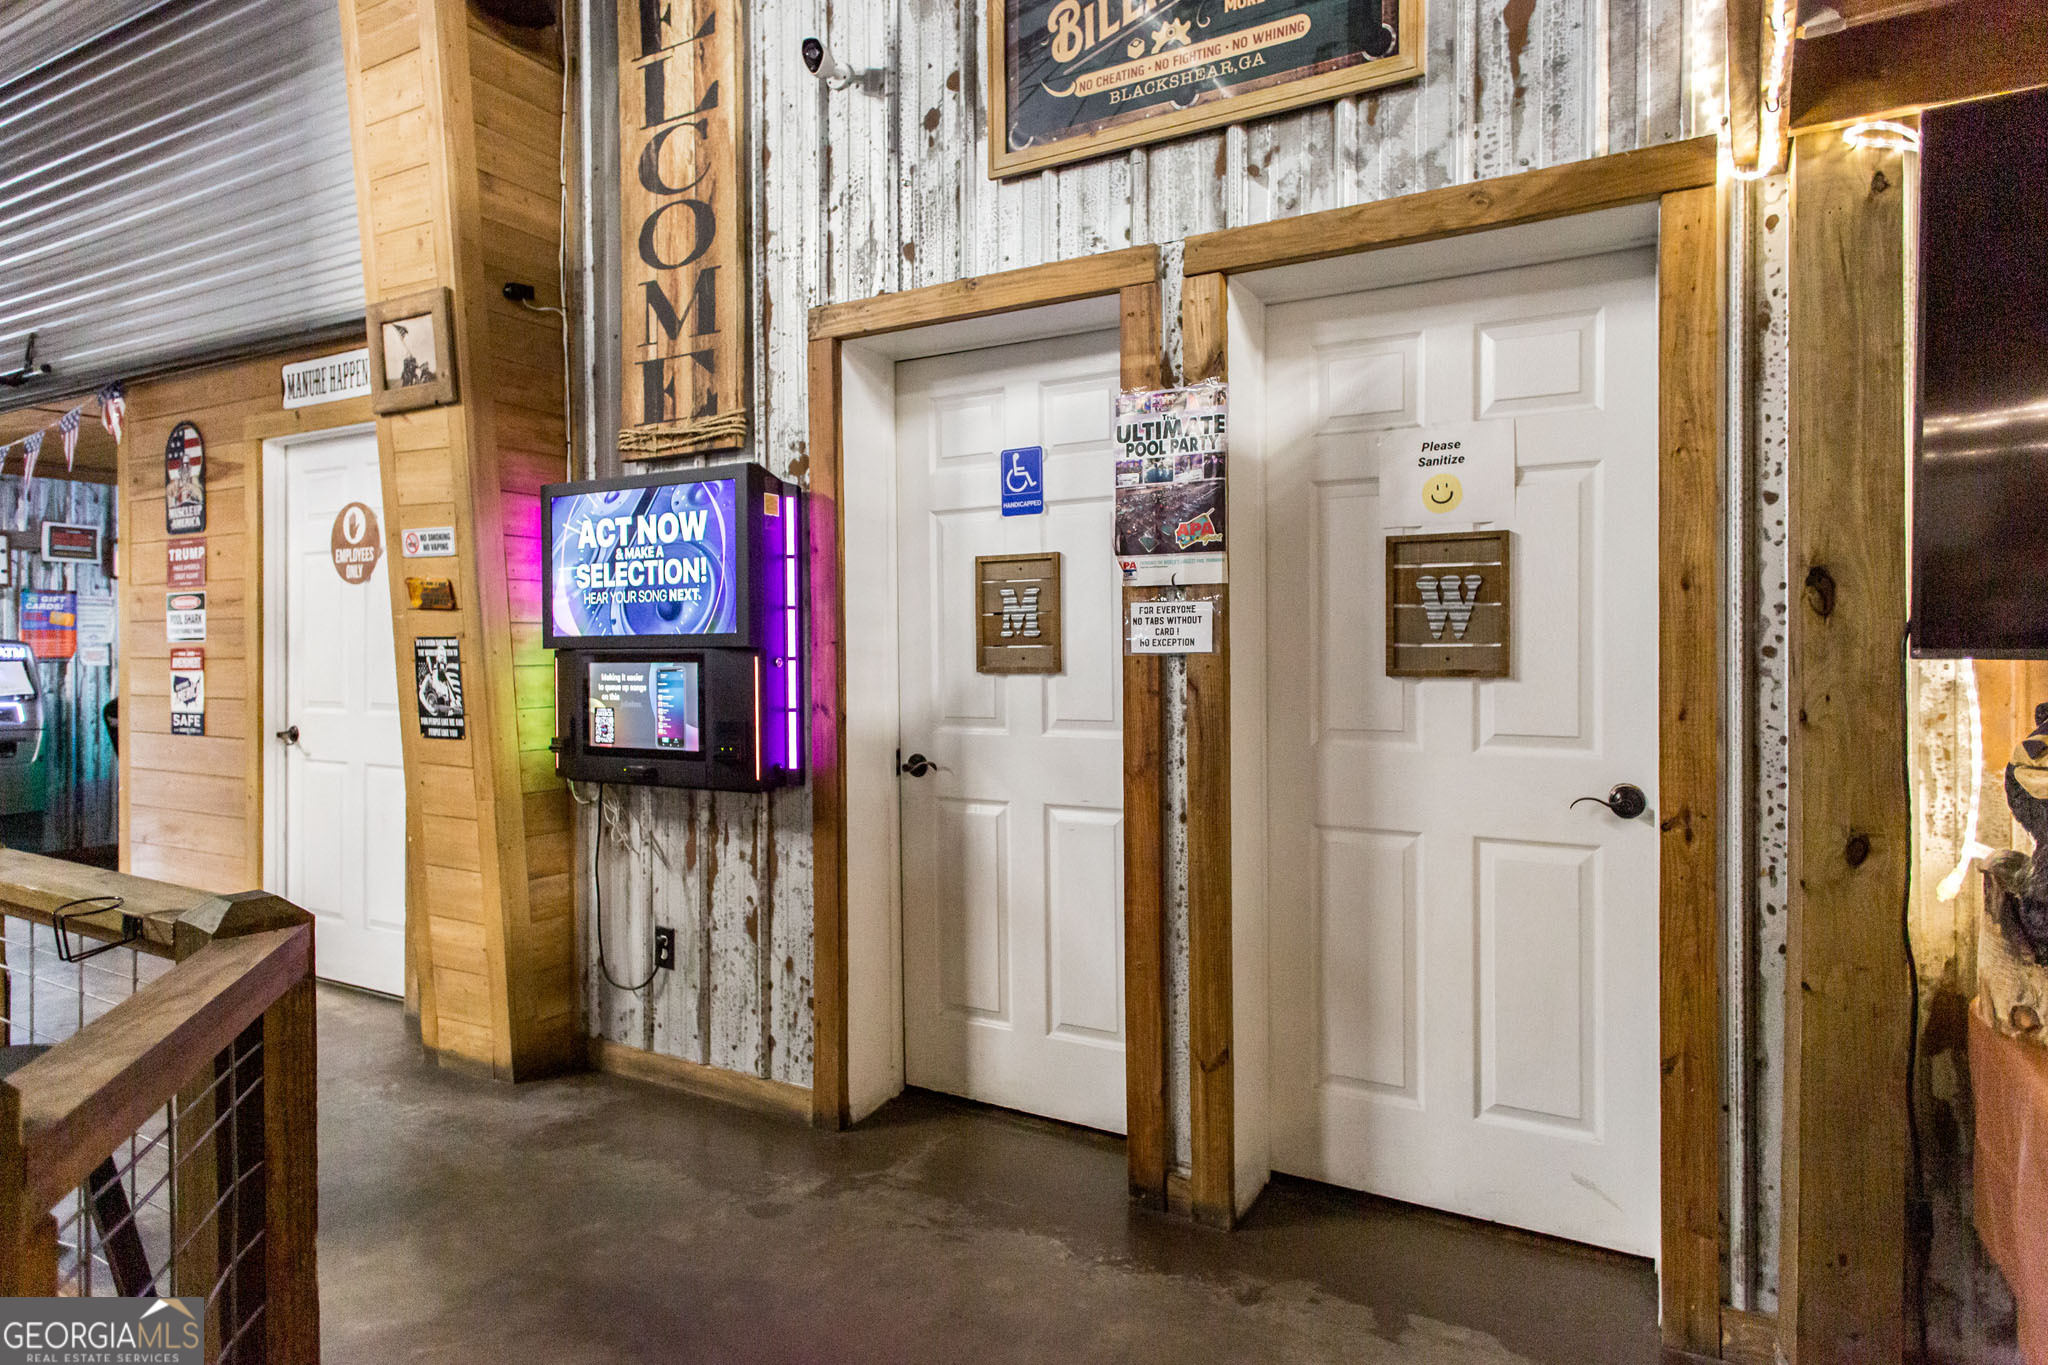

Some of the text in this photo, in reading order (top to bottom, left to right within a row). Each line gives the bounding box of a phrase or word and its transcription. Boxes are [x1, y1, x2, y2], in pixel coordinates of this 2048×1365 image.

[1079, 20, 1305, 92] NO CHEATING NO FIGHTING NO WHINING
[631, 0, 721, 427] ELCOME
[287, 358, 368, 400] MANURE HAPPEN
[1126, 434, 1219, 457] POOL PARTY
[1421, 440, 1461, 452] Please
[1418, 454, 1465, 467] Sanitize
[1003, 500, 1041, 509] HANDICAPPED
[578, 510, 708, 549] ACT NOW
[1177, 522, 1214, 536] APA
[428, 533, 451, 541] SMOKING
[169, 546, 205, 561] TRUMP
[336, 546, 375, 563] EMPLOYEES
[423, 543, 449, 551] NO VAPING
[615, 545, 664, 560] & MAKE A
[346, 564, 363, 579] ONLY
[576, 557, 707, 589] SELECTION!
[584, 588, 702, 604] HEAR YOUR SONG NEXT.
[1000, 587, 1041, 637] M
[1139, 605, 1196, 614] FOR EVERYONE
[1416, 575, 1482, 639] W
[1133, 616, 1202, 625] NO TABS WITHOUT
[1155, 628, 1174, 636] CARD
[1140, 638, 1195, 647] NO EXCEPTION
[173, 714, 201, 727] SAFE
